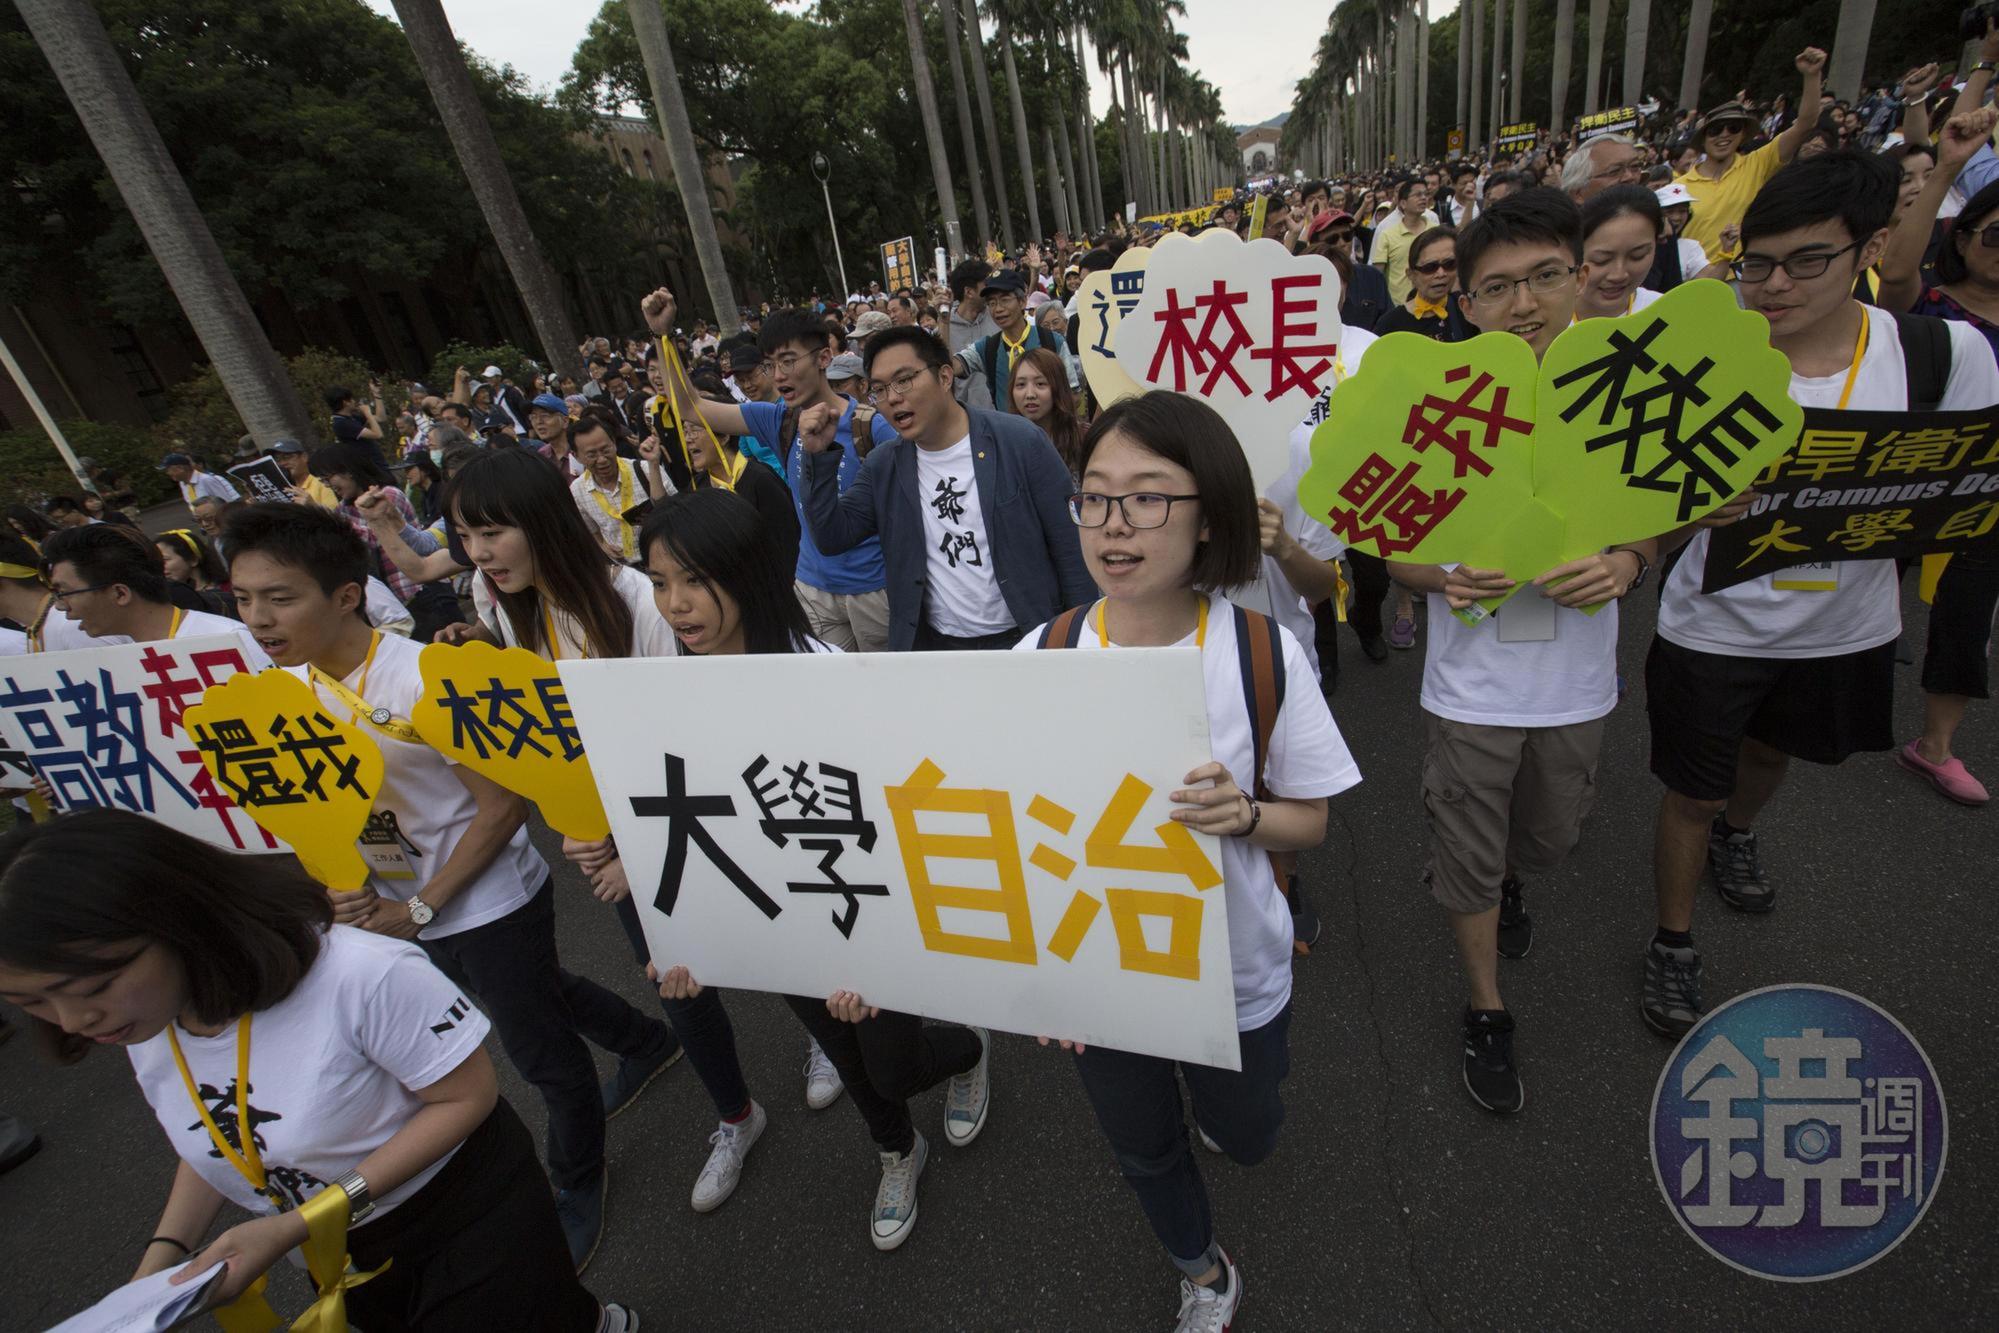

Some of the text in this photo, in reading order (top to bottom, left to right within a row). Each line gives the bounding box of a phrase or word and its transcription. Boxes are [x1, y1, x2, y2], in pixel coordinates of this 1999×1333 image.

[1146, 274, 1337, 403] 校長
[1327, 364, 1535, 559] 還我
[1552, 317, 1784, 523] 校長
[1753, 422, 1999, 485] 捍衛
[931, 477, 982, 568] 爺們
[1735, 500, 1999, 570] 大學自
[1740, 489, 1790, 521] or
[1793, 479, 1950, 509] Campus
[193, 711, 371, 808] 還我
[436, 677, 587, 762] 校長
[629, 753, 1224, 982] 大學自治
